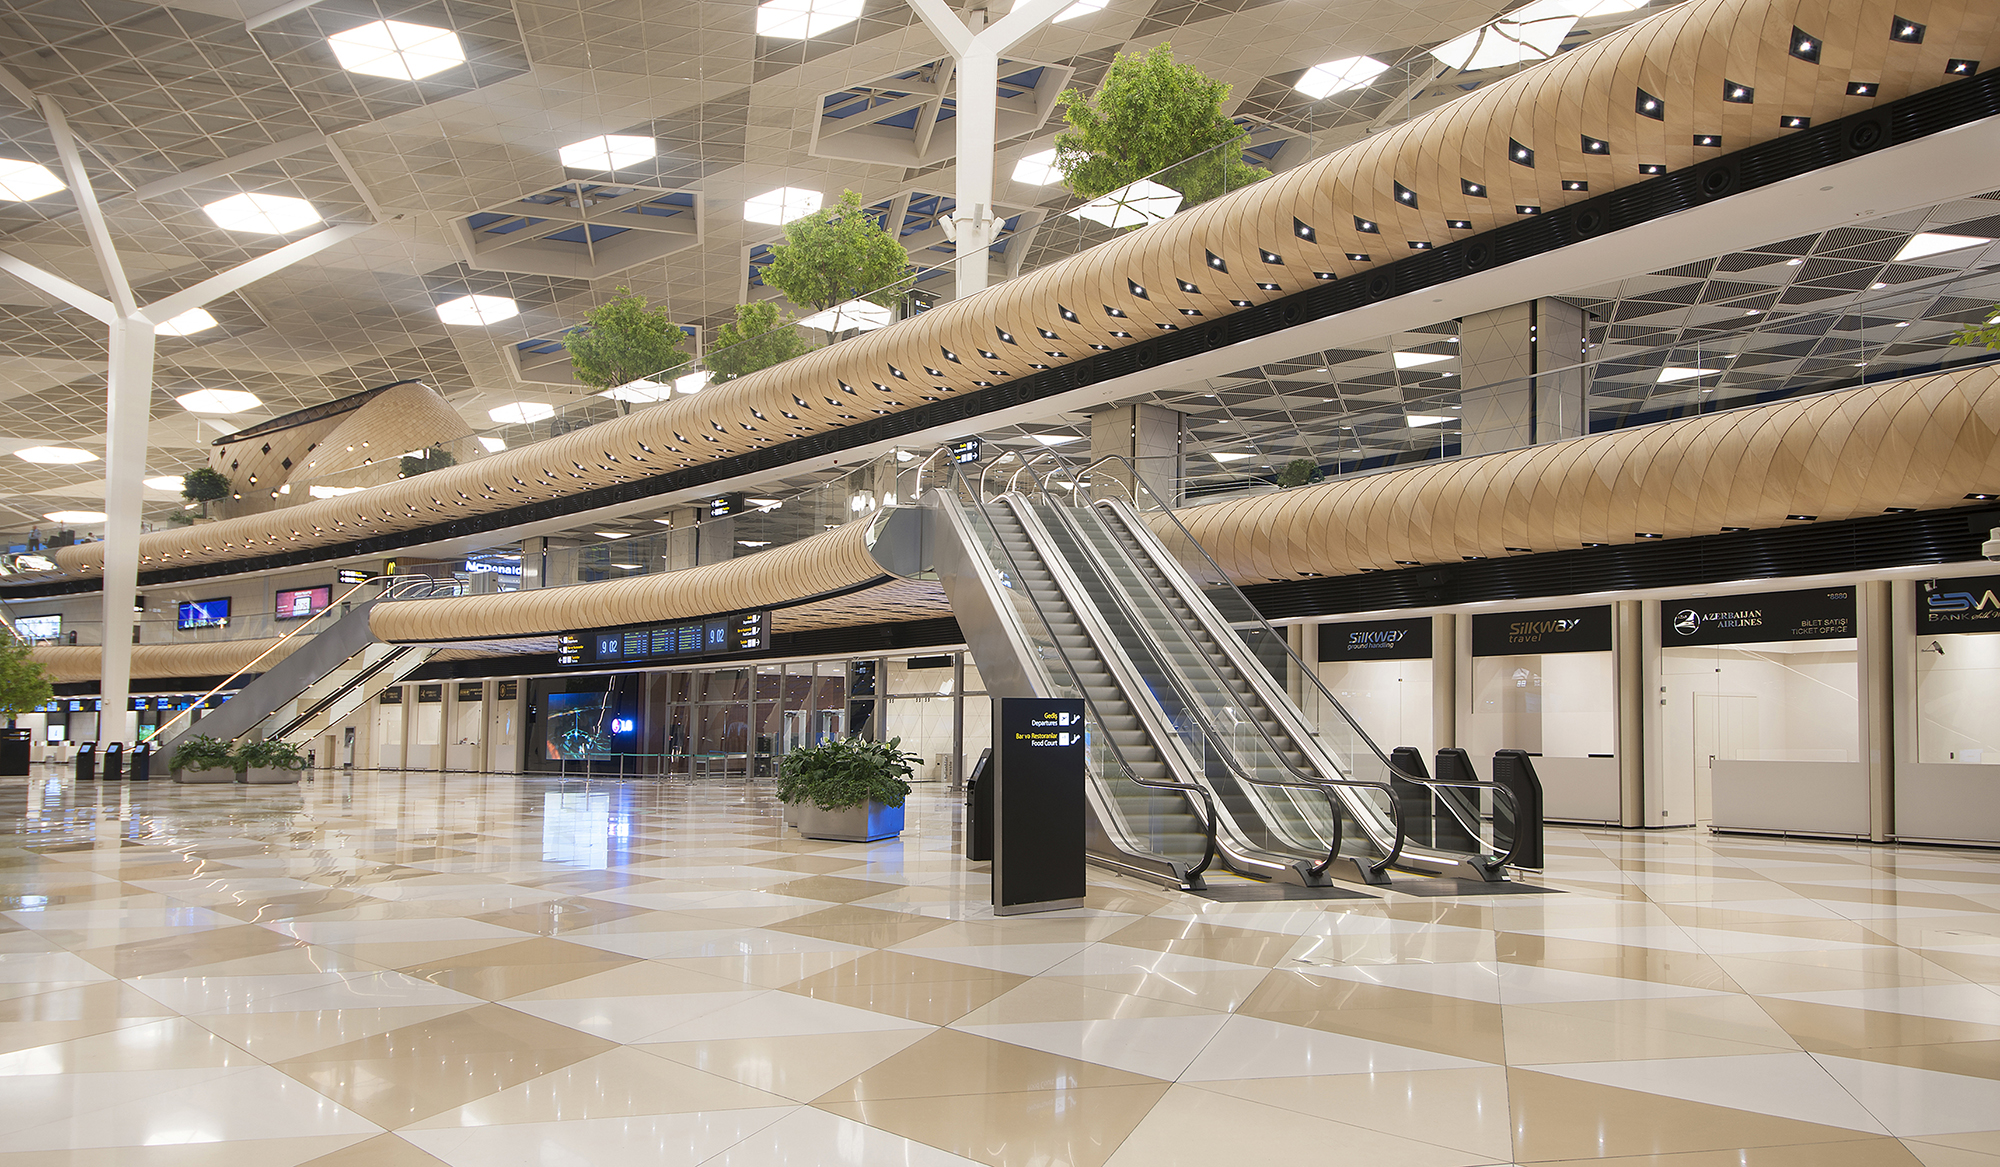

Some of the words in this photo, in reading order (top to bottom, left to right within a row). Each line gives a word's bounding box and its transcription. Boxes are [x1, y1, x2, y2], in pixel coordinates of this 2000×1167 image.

[1702, 610, 1762, 621] AZERBAIJAN
[1928, 613, 1970, 622] BANK
[1717, 618, 1762, 628] AIRLINES
[1820, 626, 1848, 634] OFFICE
[1509, 633, 1542, 643] travel
[1347, 643, 1368, 651] ground
